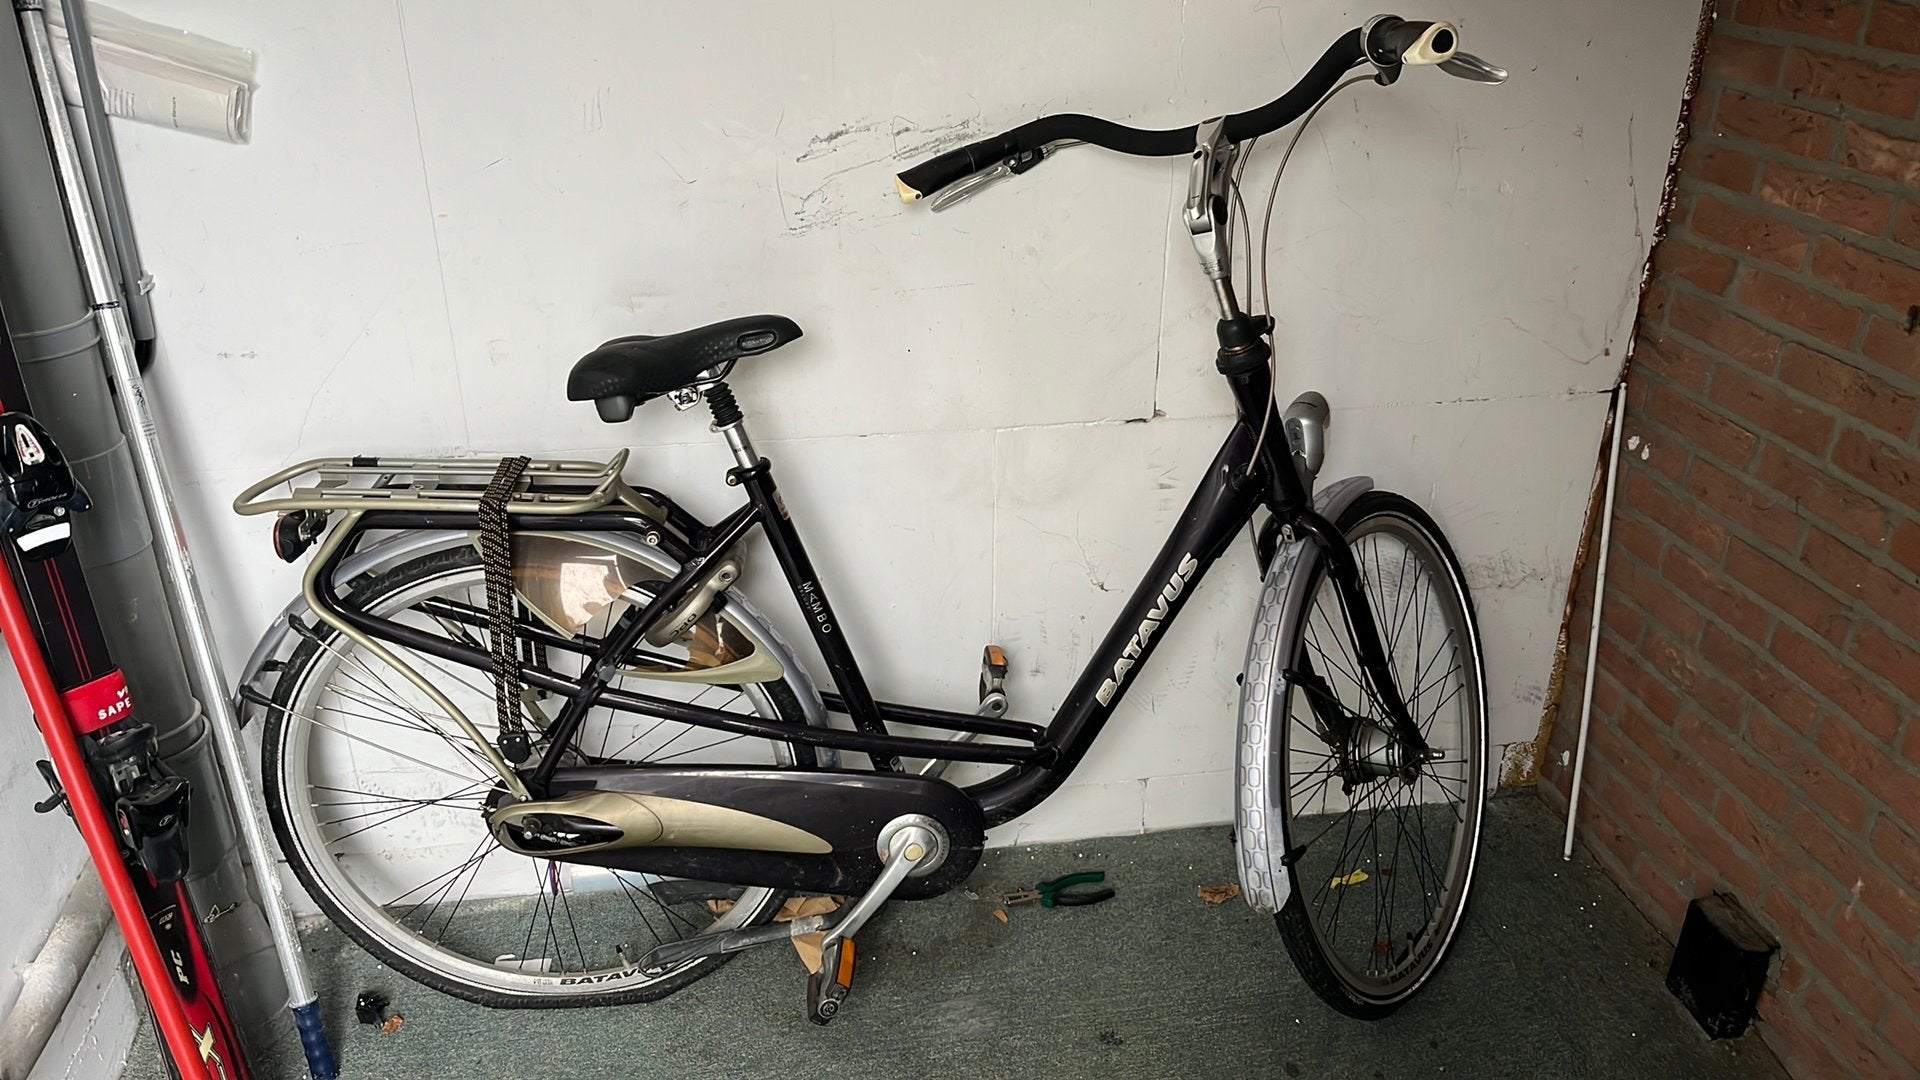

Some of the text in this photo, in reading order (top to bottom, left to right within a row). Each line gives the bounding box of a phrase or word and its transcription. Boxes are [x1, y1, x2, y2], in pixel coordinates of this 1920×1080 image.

[802, 581, 832, 633] MAMBO
[1095, 552, 1199, 708] BATAVUS
[1390, 941, 1433, 984] BATAVUS
